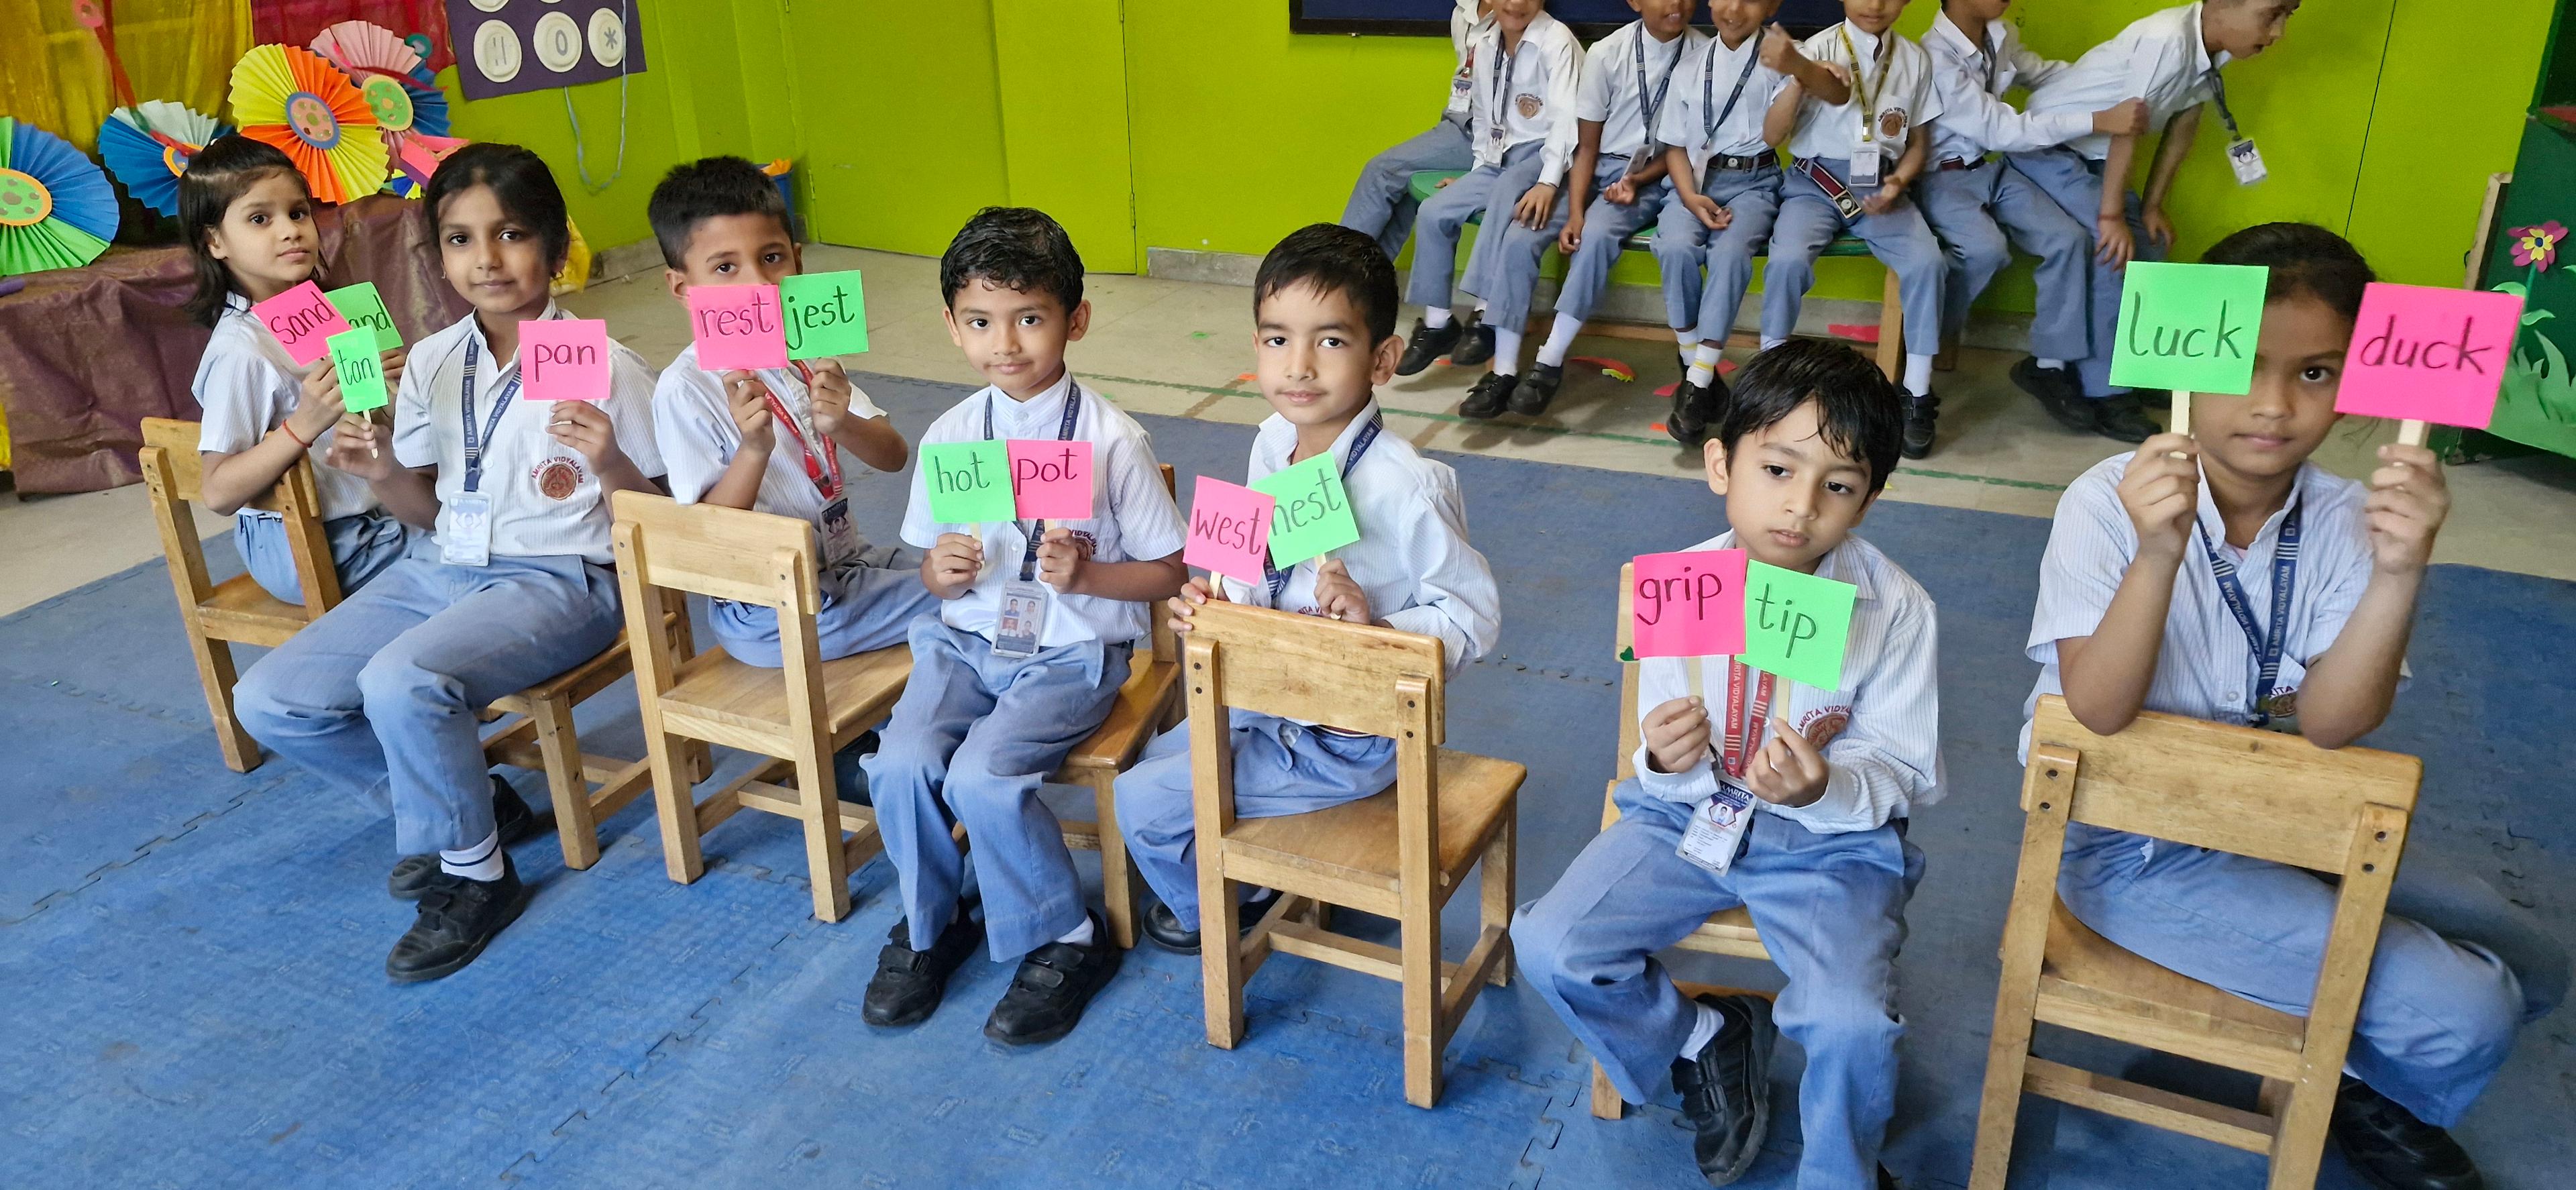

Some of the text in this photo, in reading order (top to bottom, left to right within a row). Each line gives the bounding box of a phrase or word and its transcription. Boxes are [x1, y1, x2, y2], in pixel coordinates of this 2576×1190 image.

[699, 292, 774, 337] rest
[786, 284, 855, 350] jest
[2128, 290, 2243, 359] luck
[337, 349, 374, 386] tan
[534, 344, 596, 382] pan
[2360, 315, 2497, 375] duck
[466, 412, 474, 435] AMRITA
[493, 385, 516, 419] VIDYALAYAM
[1348, 427, 1375, 462] VIDYALAYAM
[531, 456, 584, 483] AMRITA VIDYALAYAM
[934, 451, 991, 494] hot
[1016, 448, 1078, 496] pot
[1271, 468, 1342, 537] nest
[1195, 507, 1262, 555] west
[1636, 566, 1723, 626] grip
[1755, 582, 1817, 659] tip
[1731, 682, 1741, 729] VIDYALAYAM
[1797, 708, 1823, 735] AMRITA
[1722, 784, 1750, 802] AMRITA
